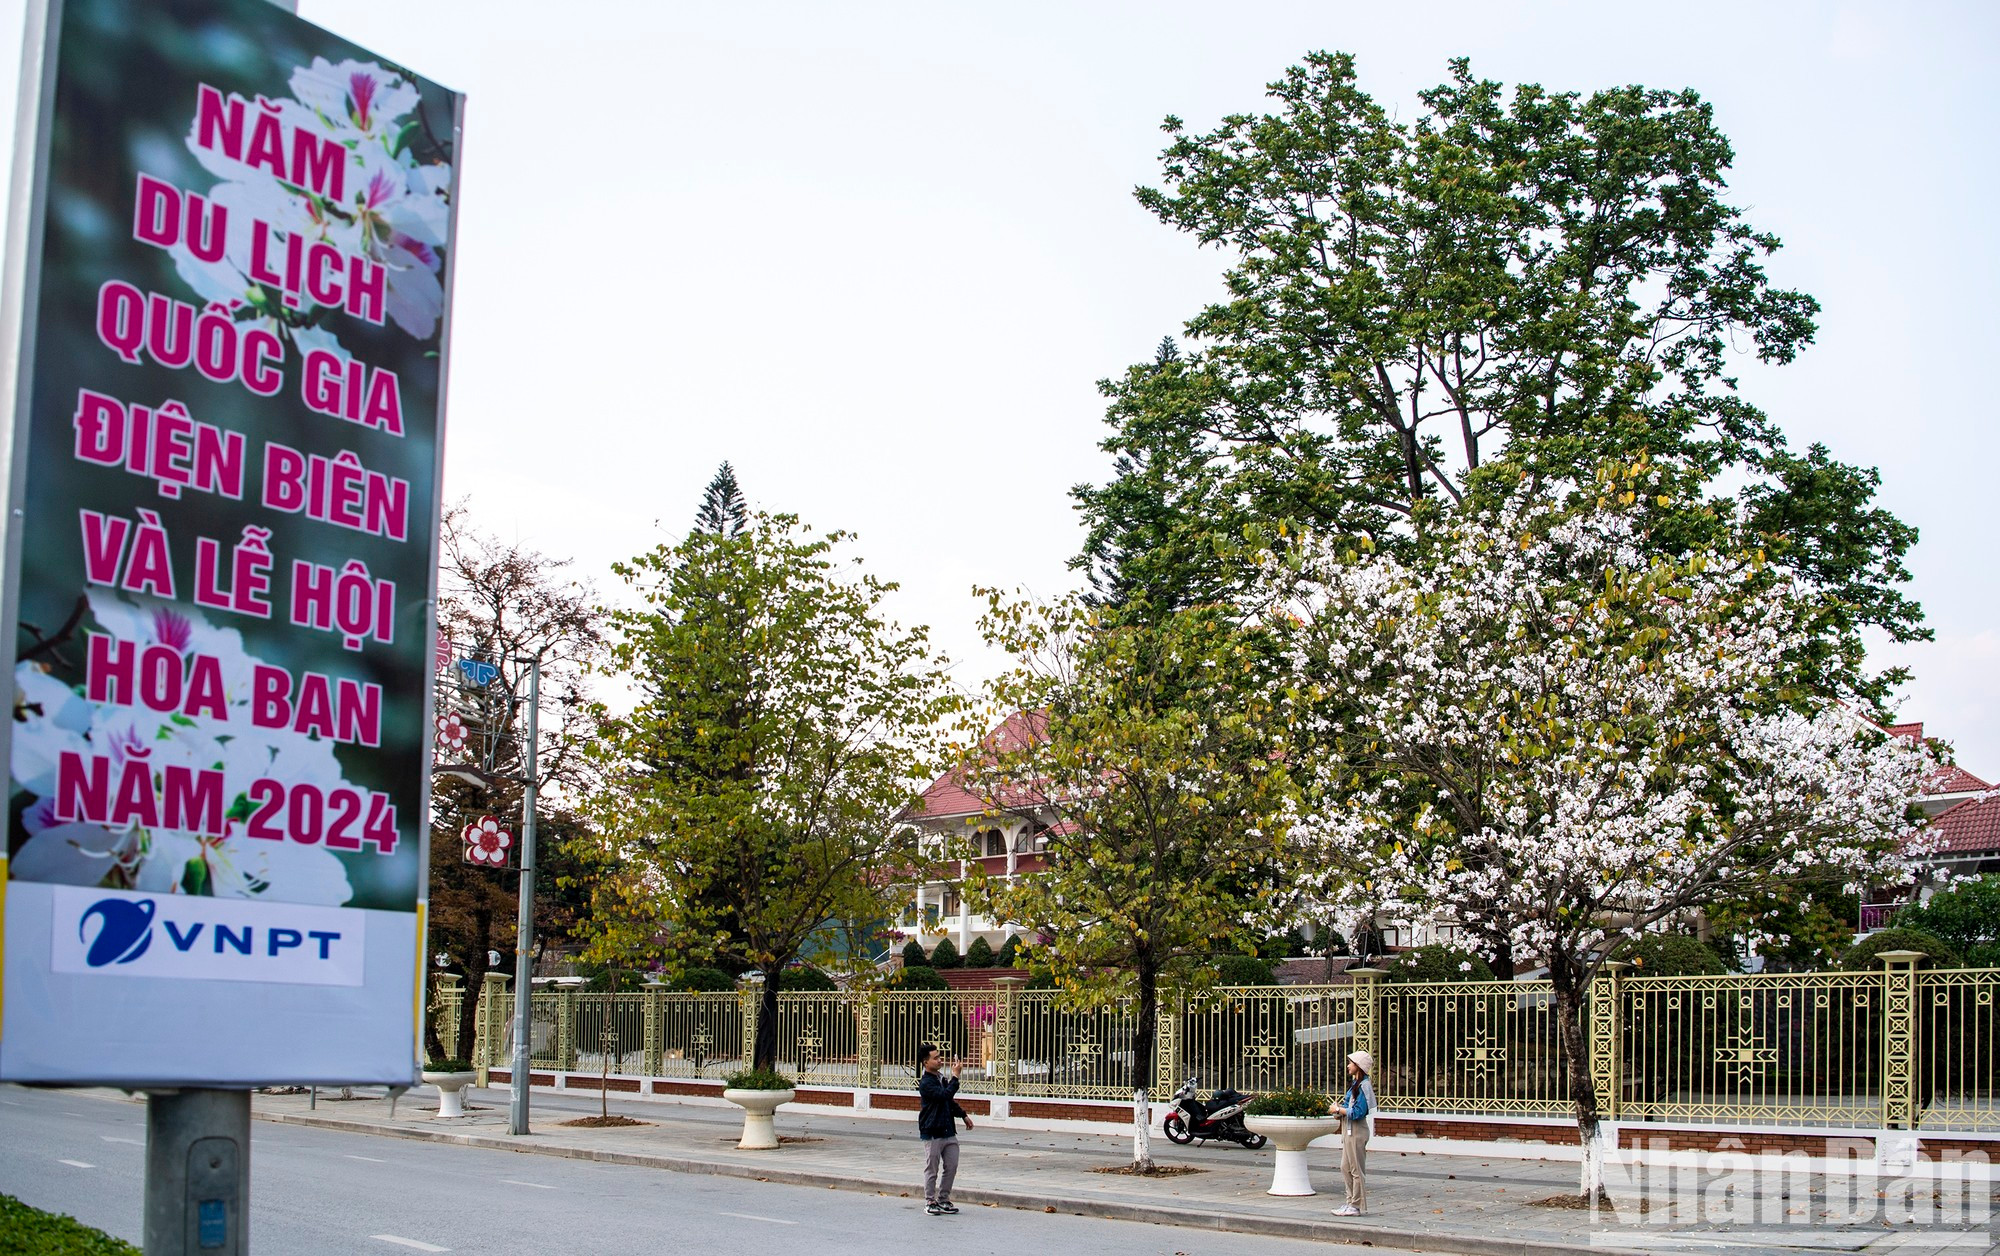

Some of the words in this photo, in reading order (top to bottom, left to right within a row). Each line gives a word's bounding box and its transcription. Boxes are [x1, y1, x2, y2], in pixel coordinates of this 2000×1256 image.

[198, 84, 347, 202] NĂM
[133, 172, 228, 264] DU
[249, 219, 386, 325] LỊCH
[97, 280, 284, 396] QUỐC
[302, 349, 405, 438] GIA
[73, 388, 246, 499] ĐIỆN
[262, 441, 409, 543] BIÊN
[79, 507, 175, 599] VÀ
[194, 525, 273, 619] LỄ
[290, 559, 396, 652] HỘI
[86, 632, 228, 722] HOA
[252, 665, 383, 748] BAN
[53, 745, 227, 838] NĂM
[246, 777, 400, 855] 2024
[163, 920, 341, 959] VNPT
